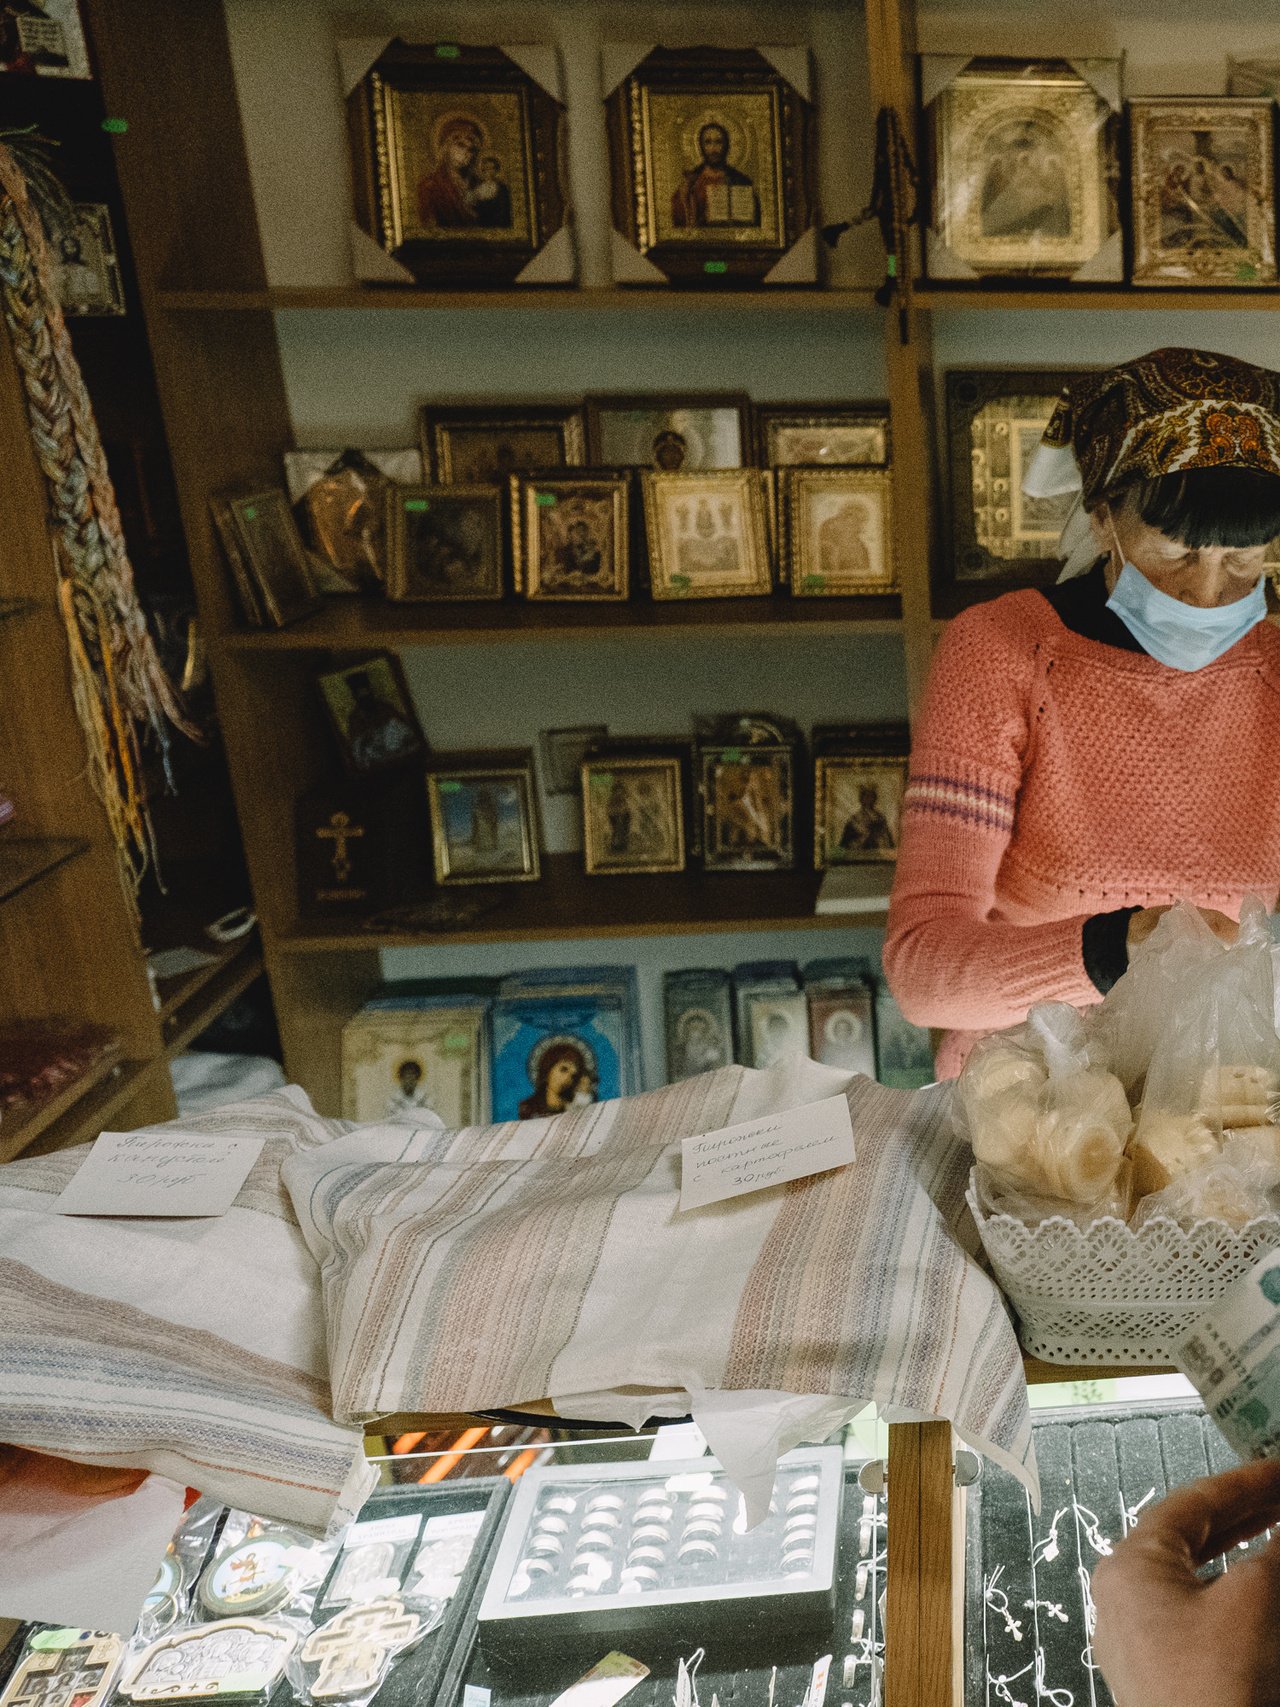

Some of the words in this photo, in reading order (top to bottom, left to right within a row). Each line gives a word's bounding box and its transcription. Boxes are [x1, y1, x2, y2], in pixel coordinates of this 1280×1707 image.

[107, 1151, 230, 1168] капустой
[696, 1139, 783, 1169] постные
[692, 1174, 704, 1183] с
